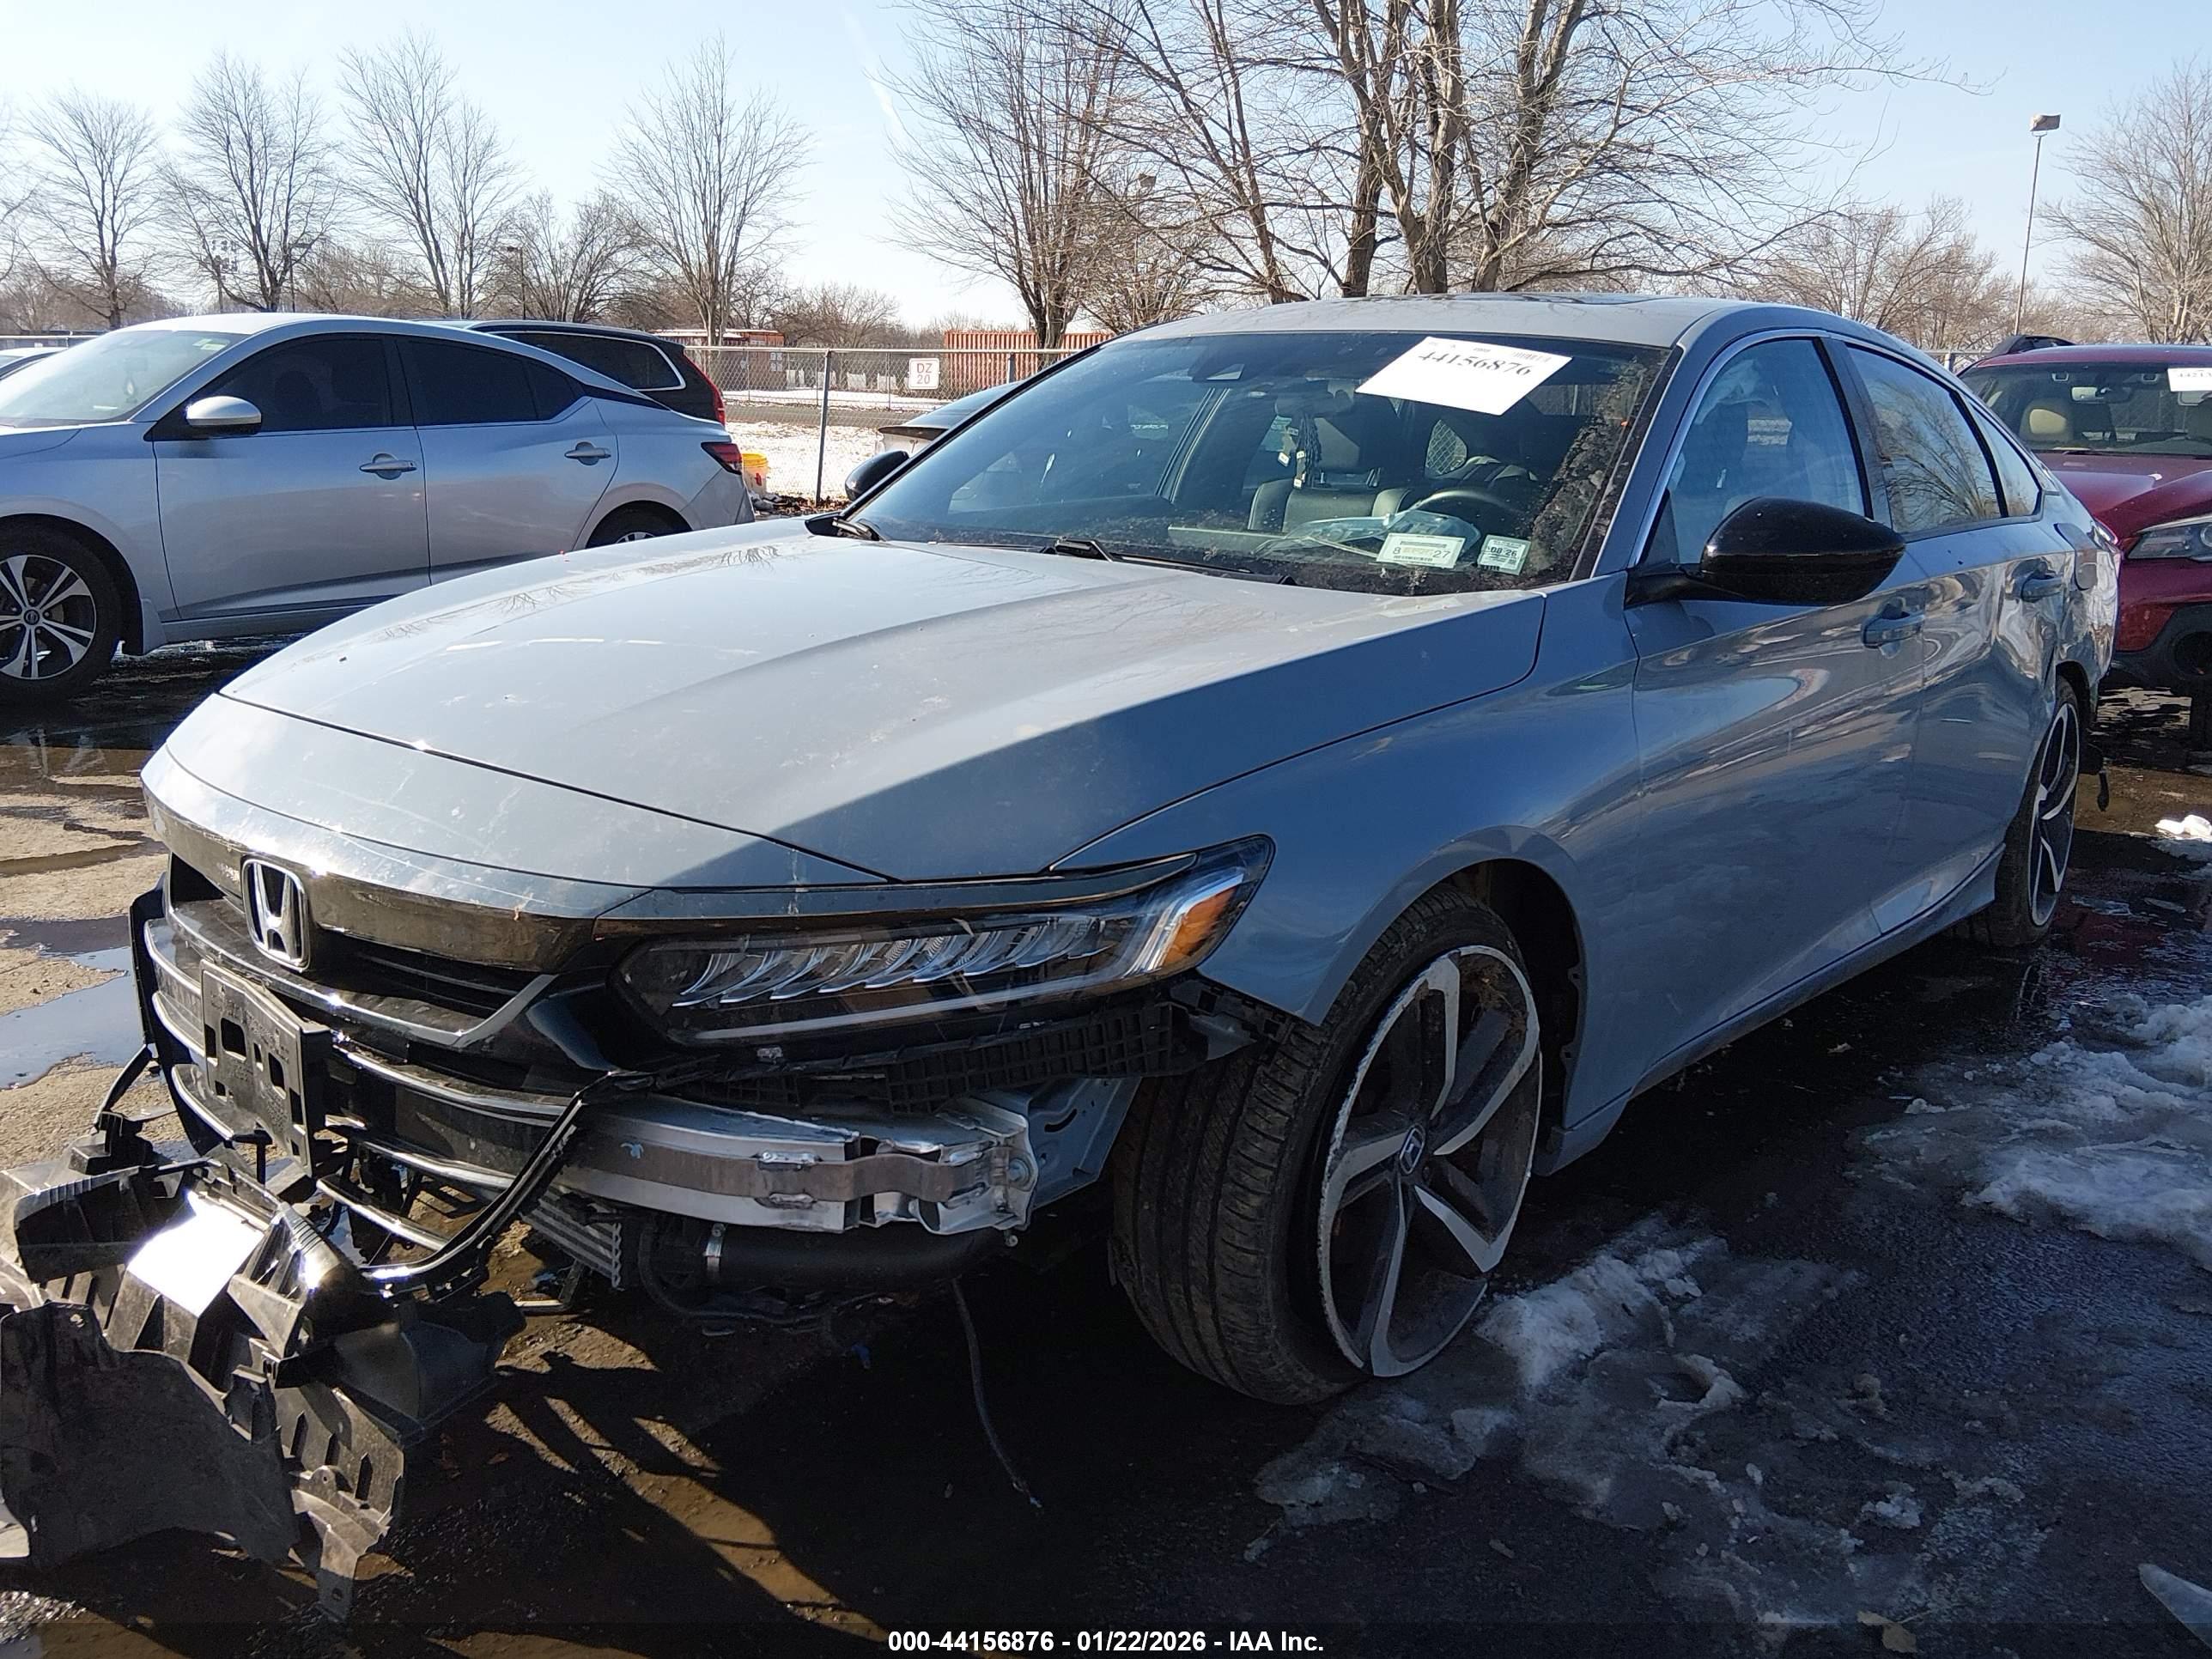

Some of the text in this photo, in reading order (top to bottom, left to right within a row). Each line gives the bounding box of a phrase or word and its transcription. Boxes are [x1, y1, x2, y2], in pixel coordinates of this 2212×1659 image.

[916, 362, 933, 374] DZ
[1418, 350, 1532, 376] 44156876
[916, 374, 931, 385] 20
[1432, 550, 1450, 558] 27
